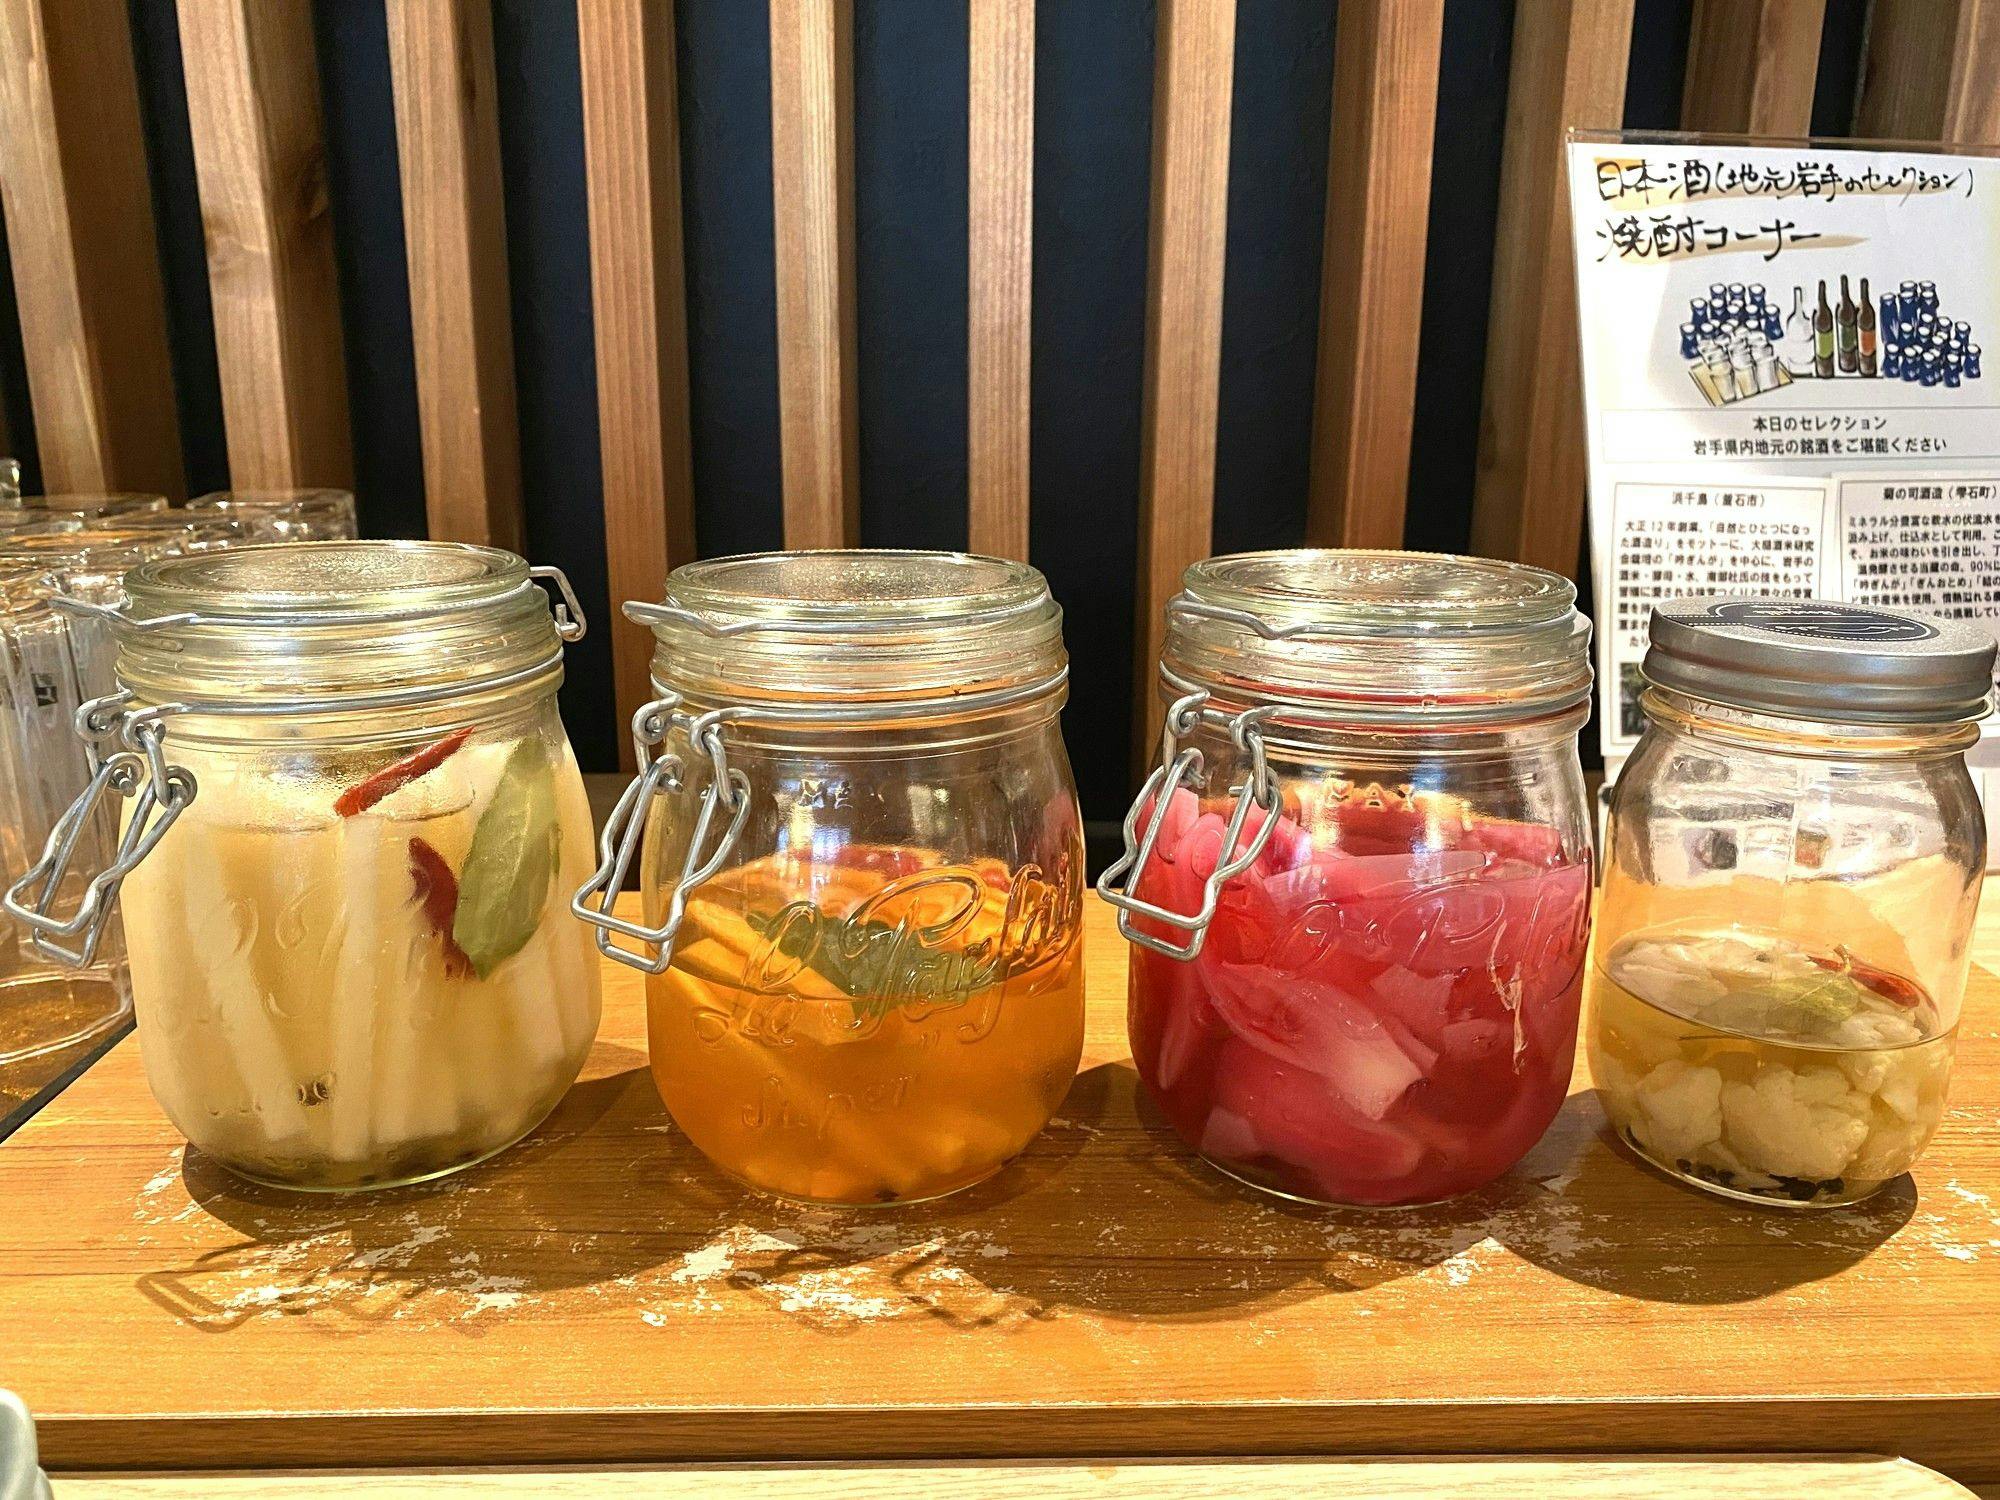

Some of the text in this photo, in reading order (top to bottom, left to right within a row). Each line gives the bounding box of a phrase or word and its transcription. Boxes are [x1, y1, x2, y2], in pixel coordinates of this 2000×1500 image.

[1596, 216, 1822, 261] 焼酎コーナー
[1753, 416, 1888, 432] 本日のセレクション
[1693, 438, 1947, 455] 岩手県内地元の銘酒をご堪能ください
